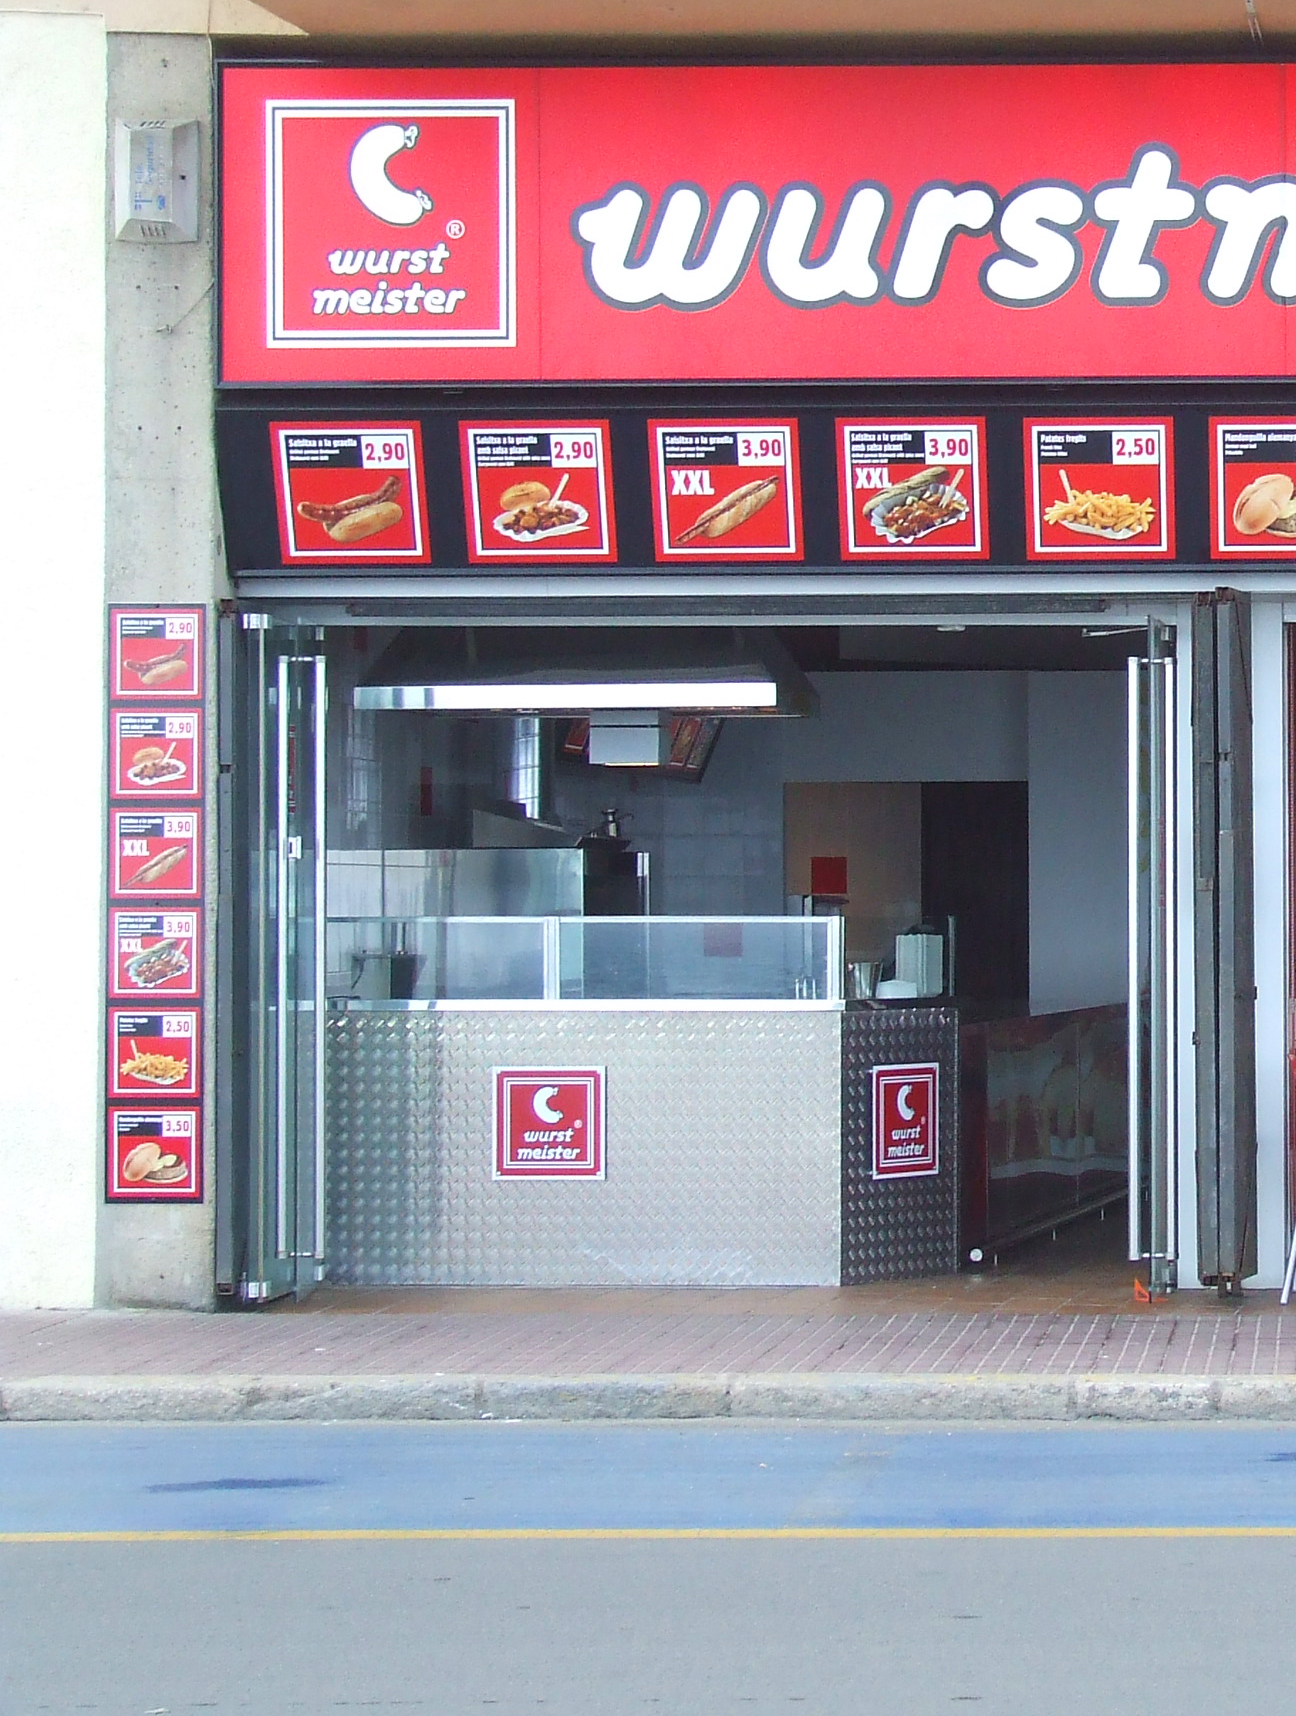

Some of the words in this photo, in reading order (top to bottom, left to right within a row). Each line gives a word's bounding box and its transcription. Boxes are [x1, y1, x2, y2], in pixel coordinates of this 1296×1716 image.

[327, 242, 450, 275] wurst
[312, 280, 466, 315] meister
[365, 442, 405, 463] 2,90
[553, 441, 594, 461] 2,90
[742, 439, 781, 459] 3,90
[929, 438, 969, 459] 3,90
[1115, 438, 1155, 458] 2,50
[671, 469, 715, 495] XXL
[855, 467, 893, 488] XXL
[122, 839, 150, 857] XXL
[524, 1128, 574, 1142] wurst
[892, 1125, 921, 1140] wurst
[517, 1145, 581, 1160] meister
[888, 1142, 925, 1157] meister
